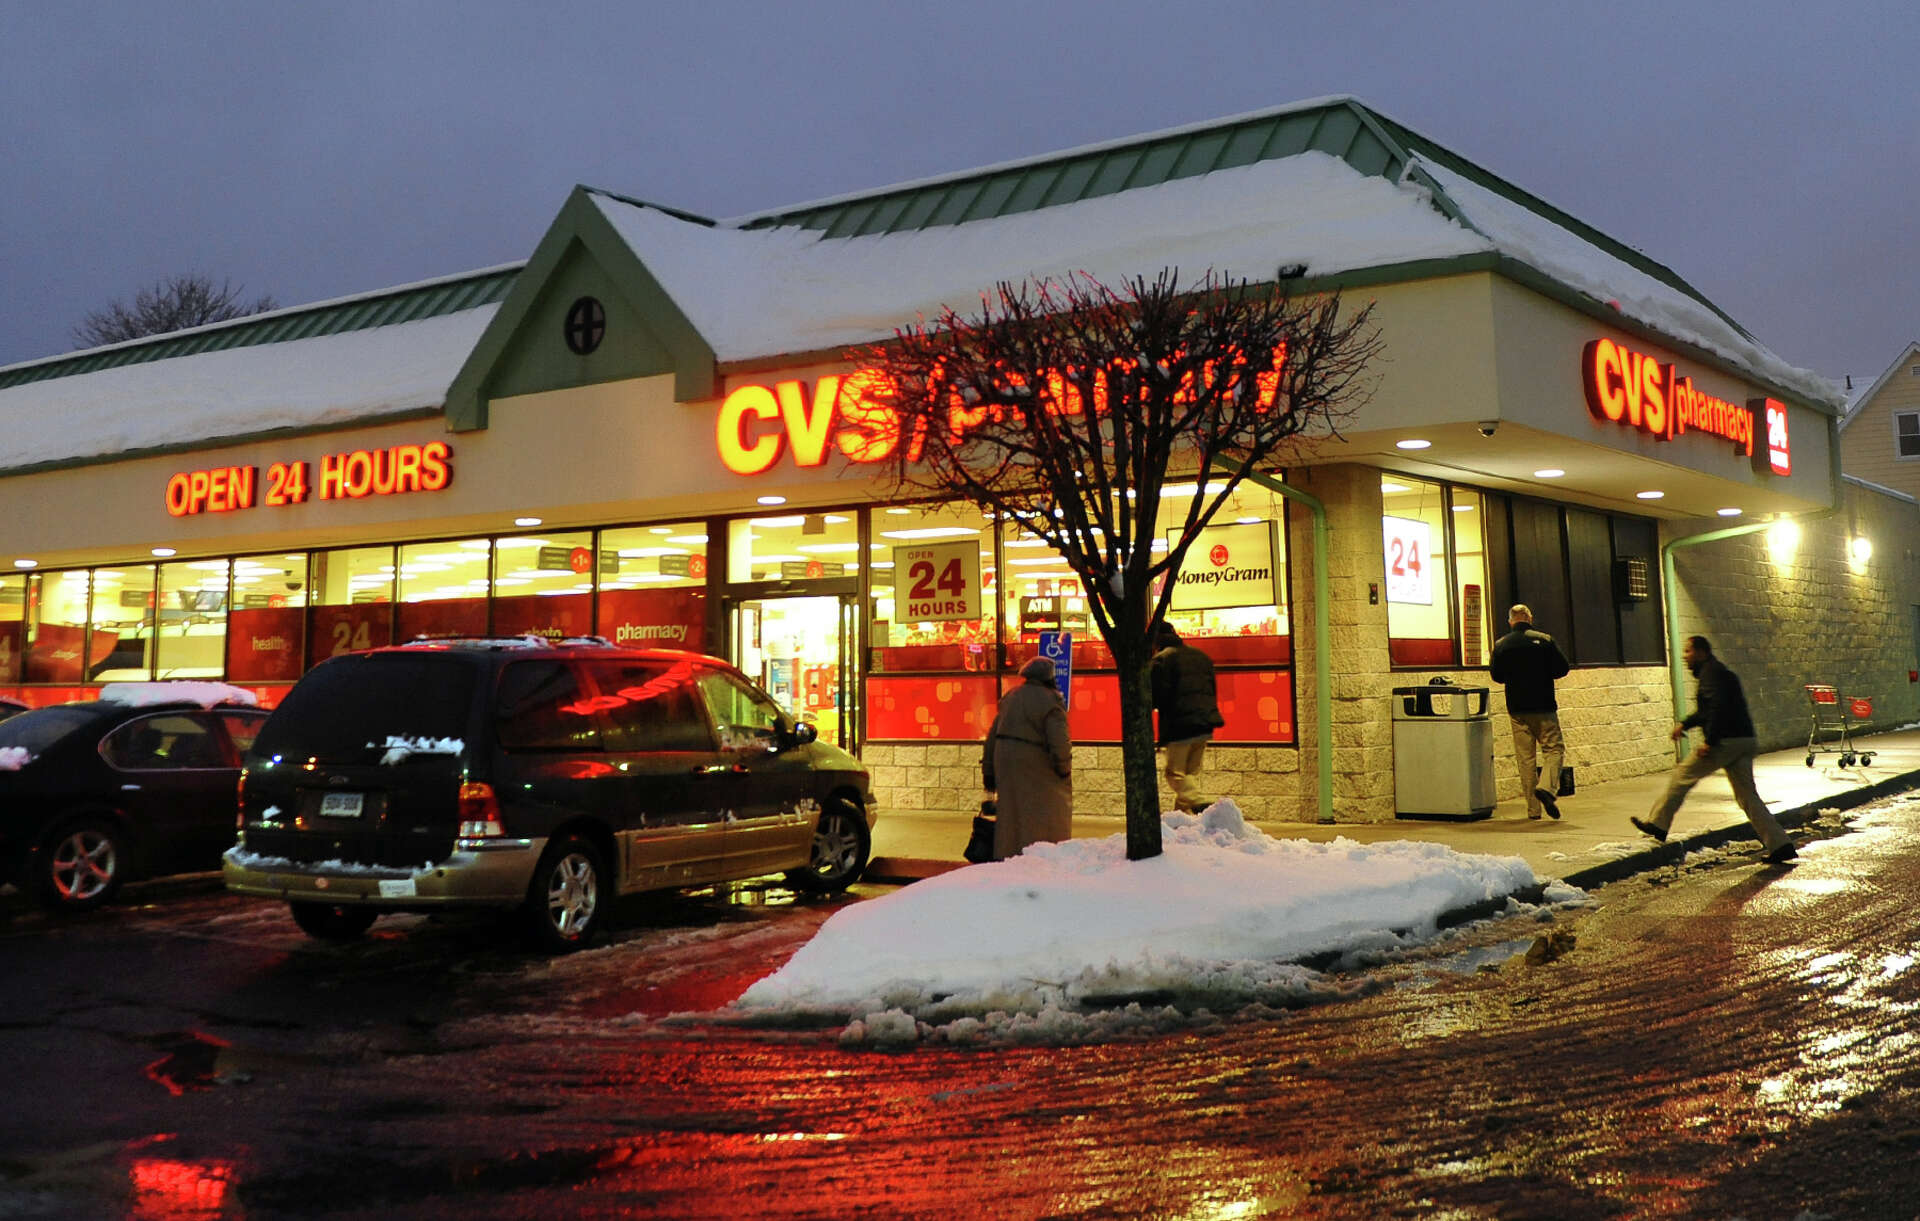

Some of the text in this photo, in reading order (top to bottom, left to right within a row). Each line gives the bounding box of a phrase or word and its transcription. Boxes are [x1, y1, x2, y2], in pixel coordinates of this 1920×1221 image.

[166, 440, 452, 517] OPEN 24 HOURS
[907, 551, 935, 560] OPEN
[1390, 536, 1422, 578] 24
[908, 557, 967, 600] 24
[1175, 566, 1270, 586] MoneyGram
[908, 600, 968, 617] HOURS
[1027, 597, 1053, 613] ATM
[332, 620, 371, 657] 24
[616, 622, 688, 643] pharmacy
[252, 635, 286, 651] health
